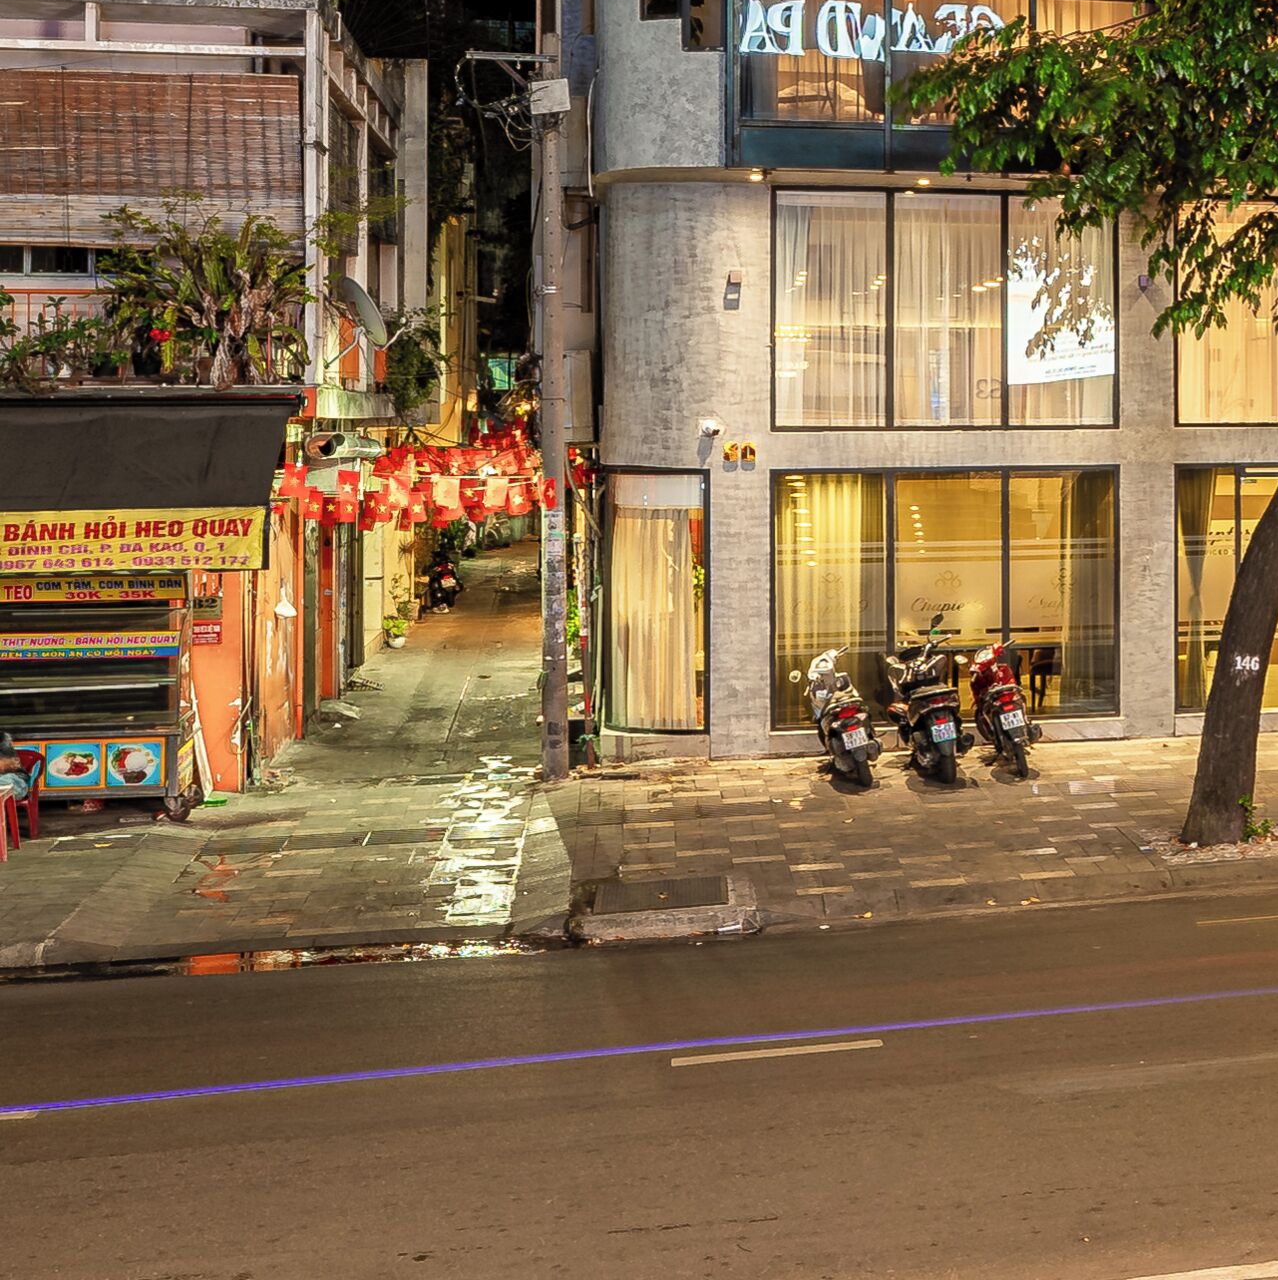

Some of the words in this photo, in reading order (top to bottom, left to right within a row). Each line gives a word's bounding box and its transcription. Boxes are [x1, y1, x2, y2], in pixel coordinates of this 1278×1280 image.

[3, 519, 76, 542] BÁNH
[84, 515, 127, 540] HỎI
[135, 520, 184, 539] HEO
[192, 518, 254, 539] QUAY
[217, 542, 225, 552] 1
[180, 555, 213, 566] 512
[64, 591, 101, 600] 30K
[119, 590, 156, 599] 35K
[1235, 655, 1260, 671] 146
